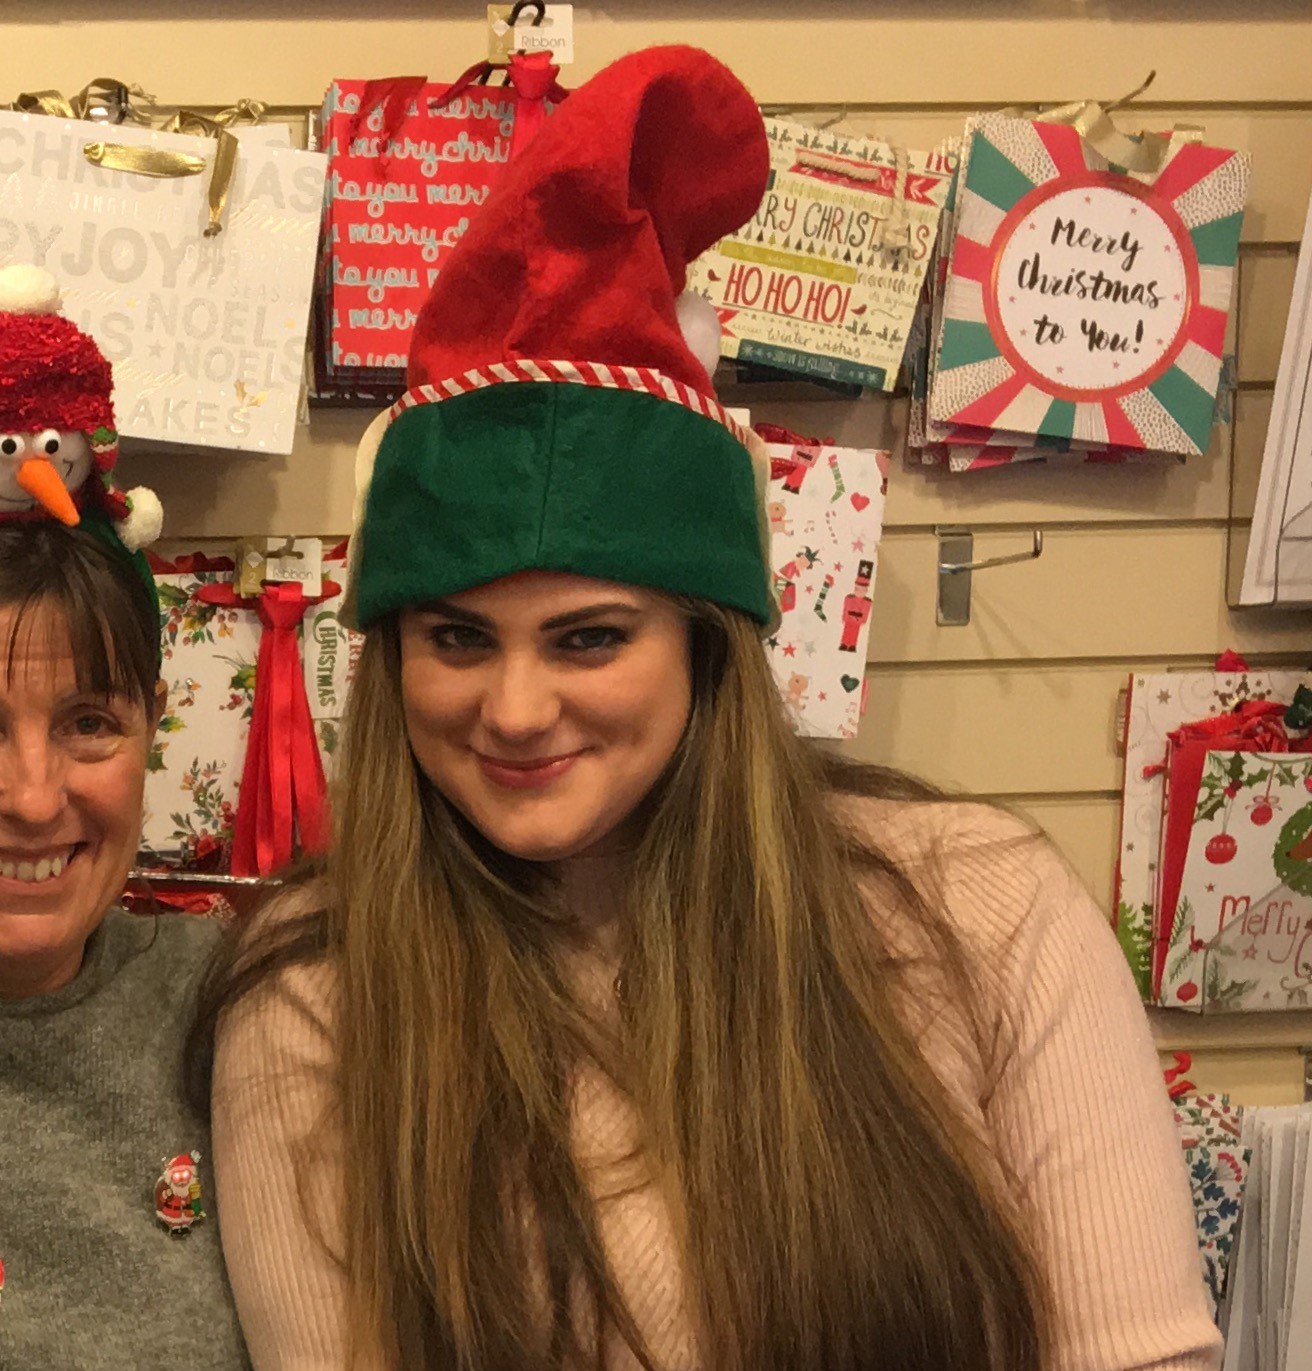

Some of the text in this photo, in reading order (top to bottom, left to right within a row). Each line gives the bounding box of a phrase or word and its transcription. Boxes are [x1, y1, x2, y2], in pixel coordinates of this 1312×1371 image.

[521, 35, 566, 48] Ribbon
[1050, 216, 1144, 272] Merry
[722, 263, 763, 306] HO
[763, 269, 804, 315] HO
[803, 281, 853, 330] HO!
[1017, 252, 1166, 310] Christmas
[145, 291, 278, 349] NOEL
[1033, 313, 1145, 354] to You!
[1218, 894, 1299, 964] Merry
